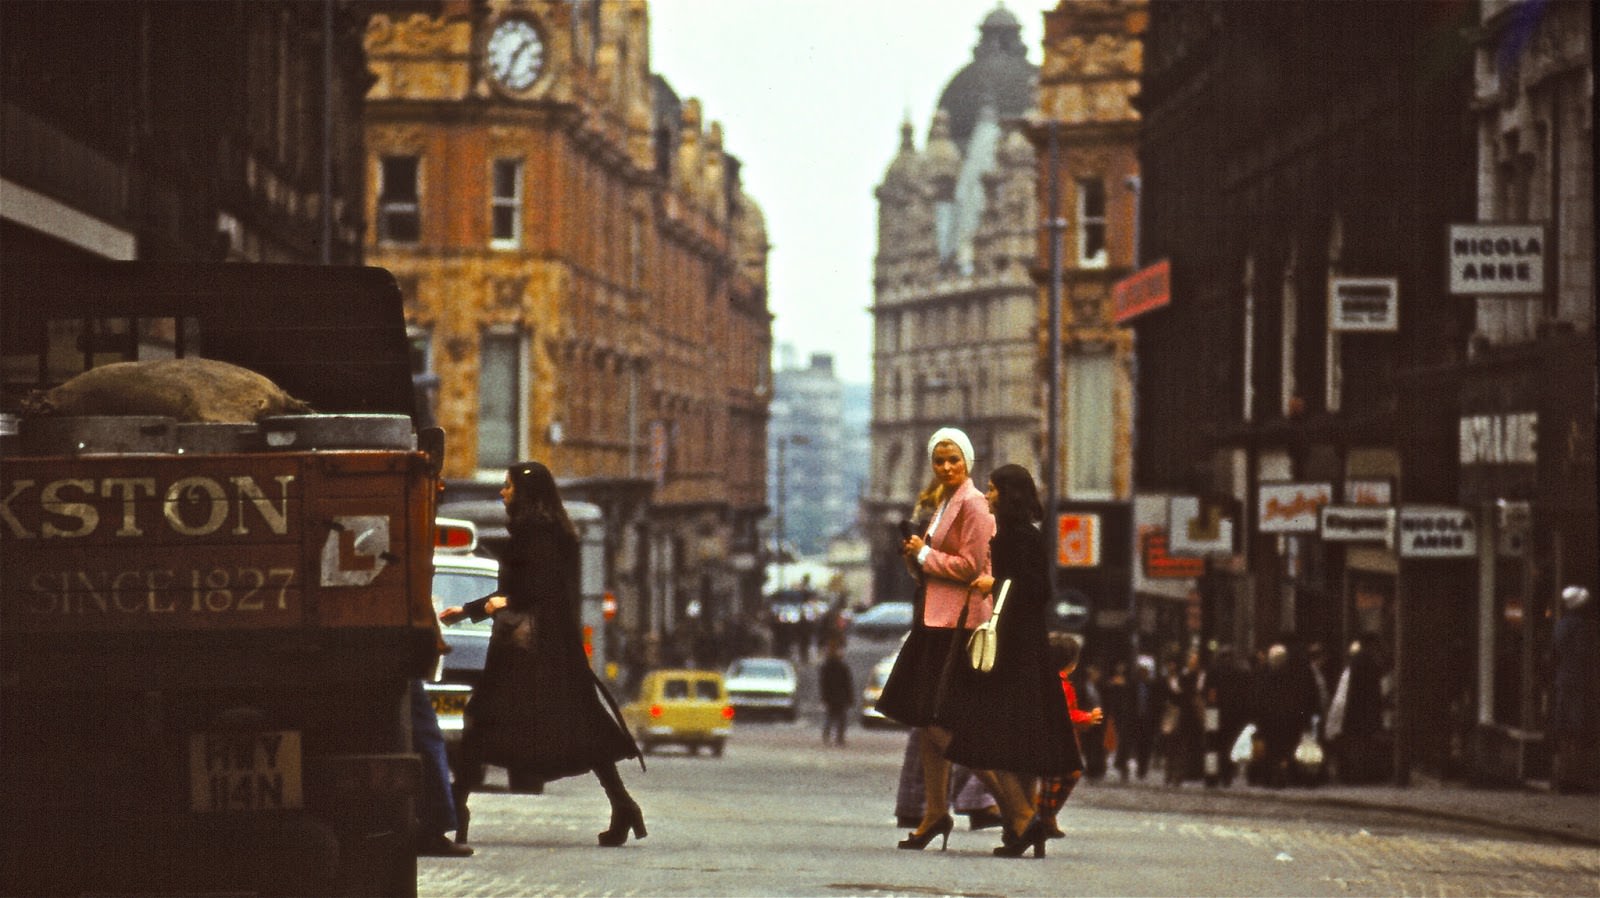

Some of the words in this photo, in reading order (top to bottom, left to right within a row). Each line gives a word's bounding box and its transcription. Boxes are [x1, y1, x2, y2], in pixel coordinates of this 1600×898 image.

[1454, 238, 1541, 256] NICOLA
[1463, 262, 1530, 281] ANNE
[1402, 517, 1474, 533] NICOLA
[339, 528, 376, 571] L
[1412, 535, 1463, 549] ANNE
[31, 568, 175, 613] SINCE
[191, 566, 295, 612] 1827
